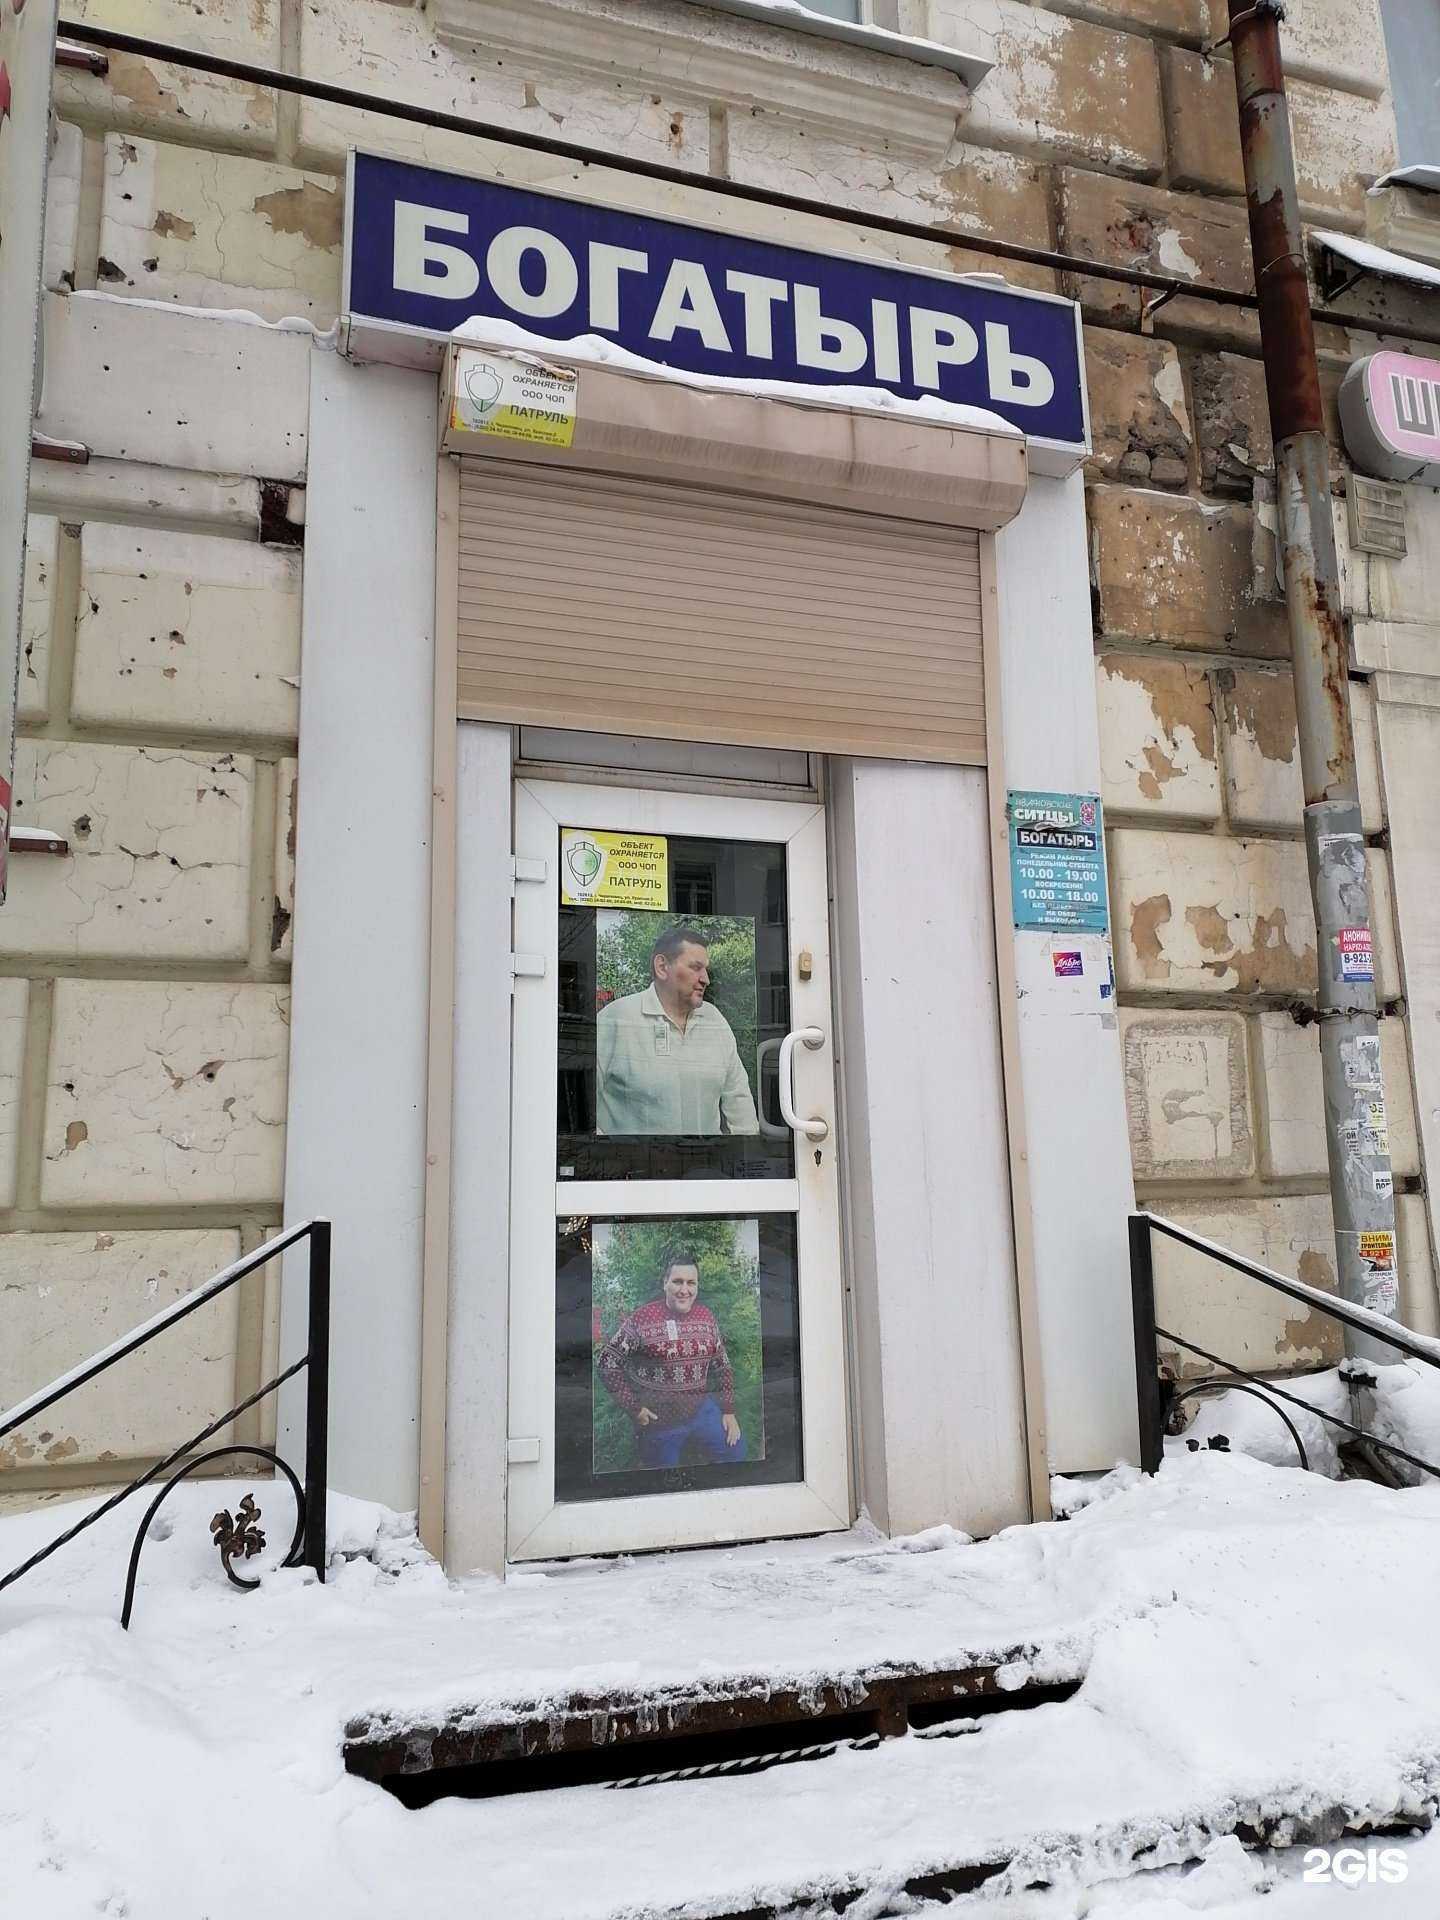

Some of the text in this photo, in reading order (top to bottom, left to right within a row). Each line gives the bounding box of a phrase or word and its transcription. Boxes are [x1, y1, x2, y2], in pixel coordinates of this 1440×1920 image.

[393, 200, 1056, 407] БОГАТЫРЬ
[512, 375, 575, 393] ОХРАНЯЕТСЯ
[522, 389, 565, 404] ООО ЧОП
[510, 404, 569, 425] ПАТРУЛЬ
[1014, 808, 1074, 823] СИТЦЫ
[620, 841, 654, 850] ОБЪЕКТ
[1020, 831, 1094, 848] БОГАТЫРЬ
[609, 849, 665, 860] ОХРАНЯЕТСЯ
[618, 861, 657, 871] ООО ЧОП
[1020, 868, 1054, 879] 10.00
[1065, 870, 1097, 881] 19.00
[609, 877, 662, 889] ПАТРУЛЬ
[1021, 889, 1055, 900] 10.00
[1066, 891, 1098, 902] 18.00
